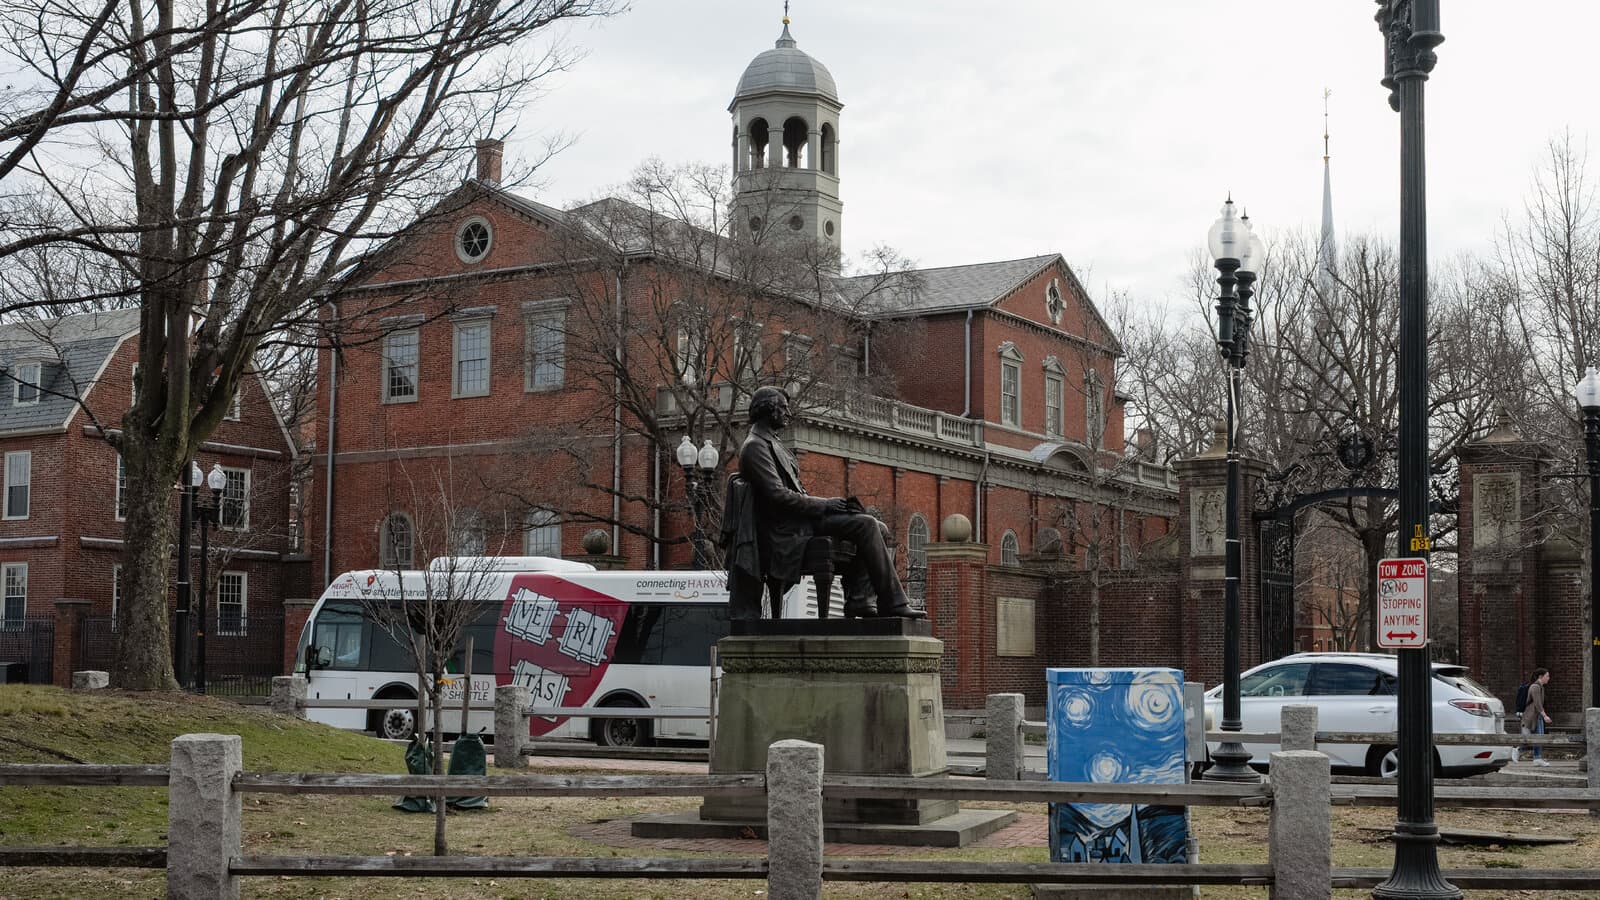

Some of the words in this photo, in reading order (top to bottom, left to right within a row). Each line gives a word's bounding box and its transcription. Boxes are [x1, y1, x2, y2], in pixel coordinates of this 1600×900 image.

[1380, 565, 1398, 577] TOW
[1402, 564, 1425, 576] ZONE
[636, 579, 687, 590] connecting
[687, 580, 727, 589] HARVA
[1394, 582, 1408, 593] NO
[1383, 599, 1421, 609] STOPPING
[520, 600, 544, 626] VE
[1383, 614, 1421, 626] ANYTIME
[572, 621, 598, 646] RI
[440, 680, 490, 691] ARVRD
[524, 671, 556, 701] TAS
